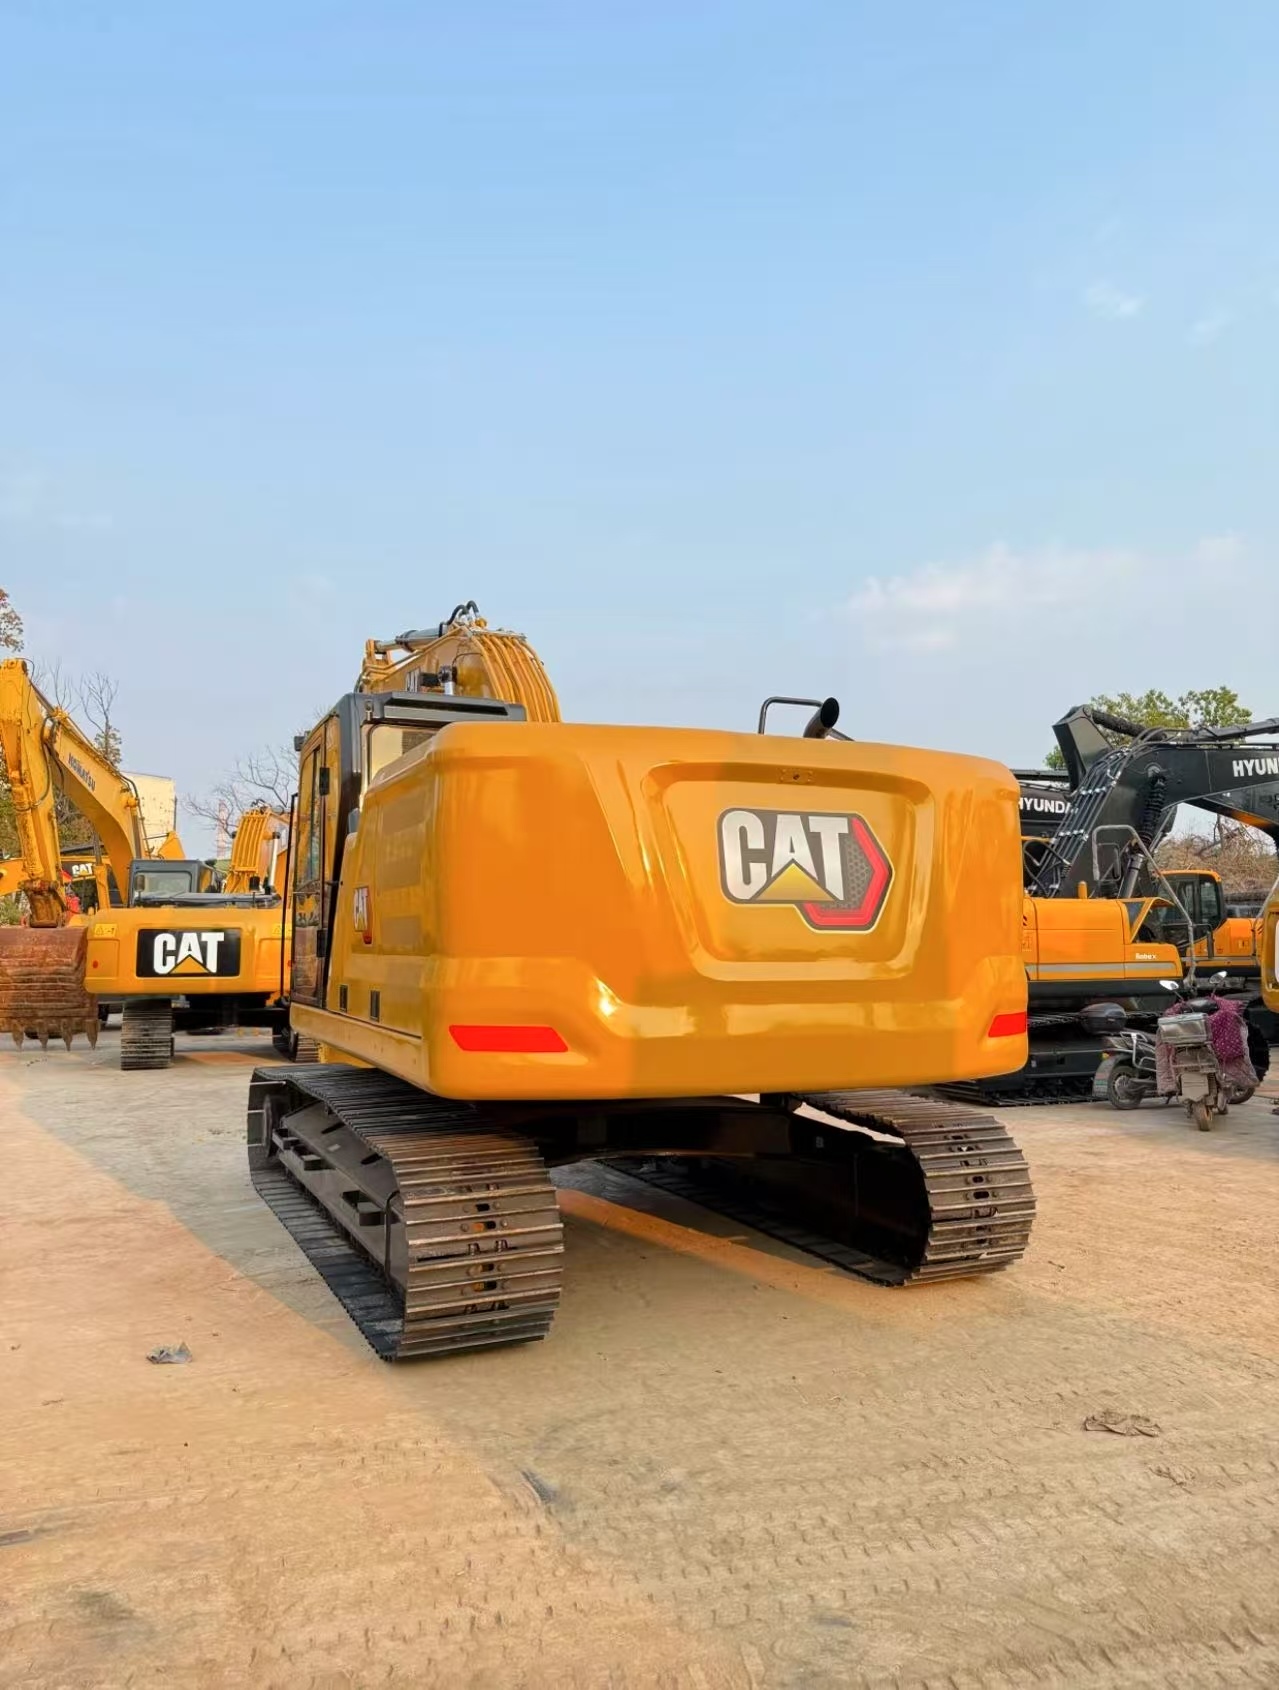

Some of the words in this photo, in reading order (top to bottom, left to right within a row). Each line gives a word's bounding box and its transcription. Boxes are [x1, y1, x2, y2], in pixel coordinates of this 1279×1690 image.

[1232, 757, 1279, 777] HYUN
[71, 862, 94, 877] CAT
[721, 810, 849, 901] CAT
[353, 887, 368, 931] CAT
[153, 931, 225, 975] CAT
